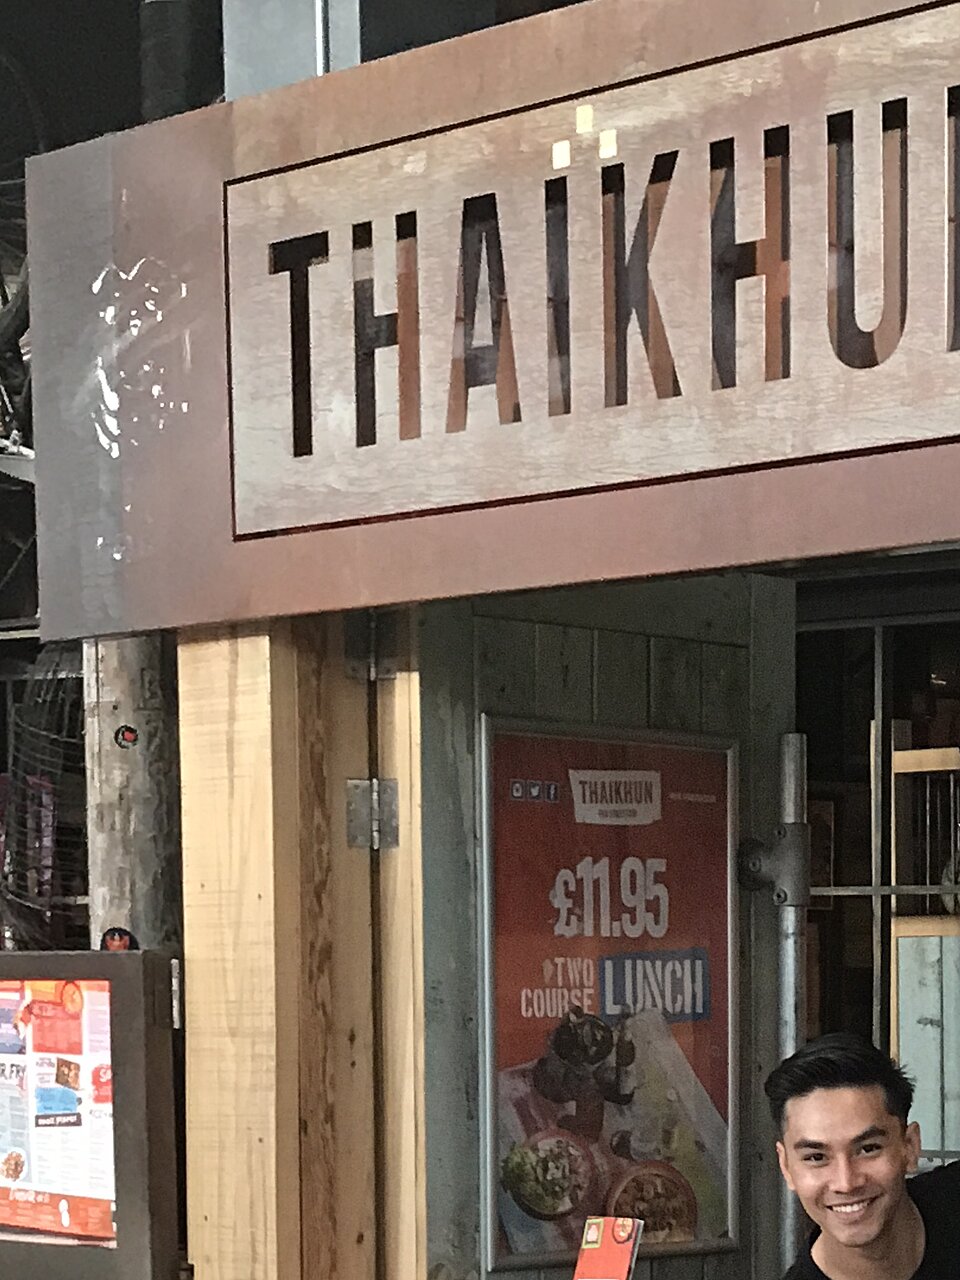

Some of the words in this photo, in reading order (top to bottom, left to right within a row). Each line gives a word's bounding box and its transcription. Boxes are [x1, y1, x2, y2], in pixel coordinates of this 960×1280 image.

[579, 780, 653, 805] THAIKHUN
[551, 856, 669, 938] £11.95
[554, 957, 595, 988] TWO
[605, 959, 703, 1016] LUNCH
[521, 988, 595, 1018] COURSE
